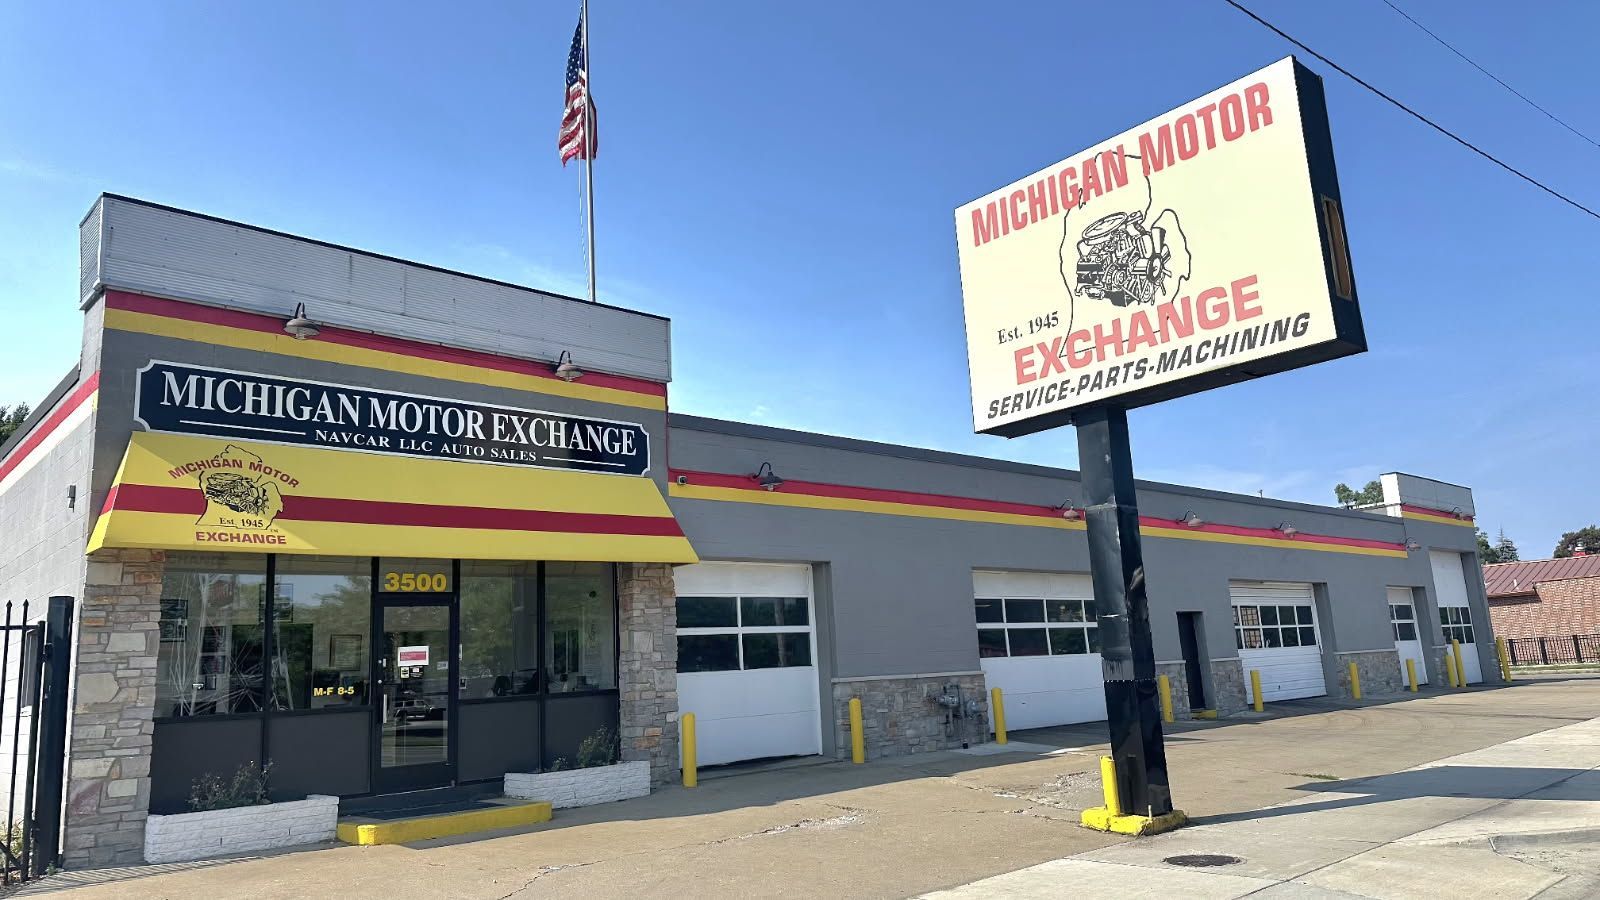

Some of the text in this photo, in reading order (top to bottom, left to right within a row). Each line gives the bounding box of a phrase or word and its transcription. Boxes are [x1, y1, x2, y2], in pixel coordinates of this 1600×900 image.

[971, 82, 1273, 247] MICHIGAN MOTOR
[997, 311, 1060, 345] Est. 1945
[1014, 274, 1263, 385] EXCHANGE
[987, 312, 1310, 419] SERVICE-PARTS-MACHINING
[160, 371, 637, 456] MICHIGAN MOTOR EXCHANGE
[315, 429, 537, 462] NAVCAR LLC AUTO SALES
[168, 458, 300, 488] MICHIGAN MOTOR
[195, 531, 287, 545] EXCHANGE
[241, 518, 264, 528] 1945
[384, 572, 447, 592] 3500
[337, 686, 355, 695] 8-5
